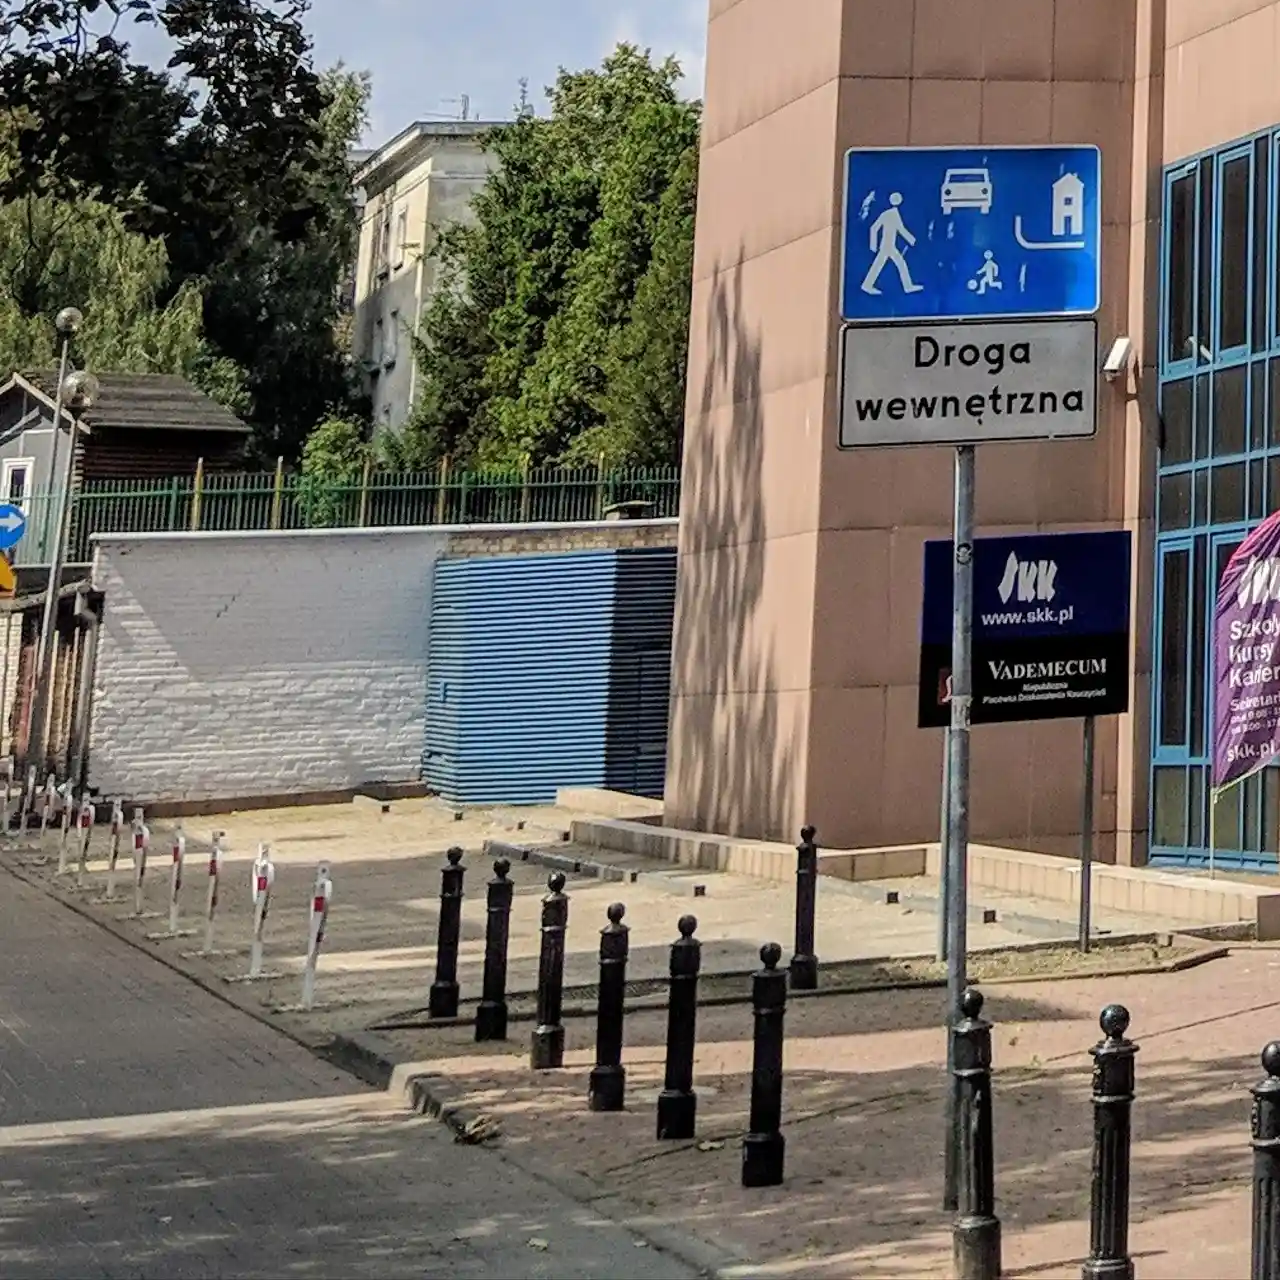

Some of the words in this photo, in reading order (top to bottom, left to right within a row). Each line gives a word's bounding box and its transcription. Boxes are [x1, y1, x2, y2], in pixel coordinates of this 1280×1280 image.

[914, 335, 1031, 374] Droga
[855, 385, 1084, 425] wewnętrzna
[981, 605, 1074, 626] www.skk.pl
[1227, 739, 1276, 762] skk.pl
